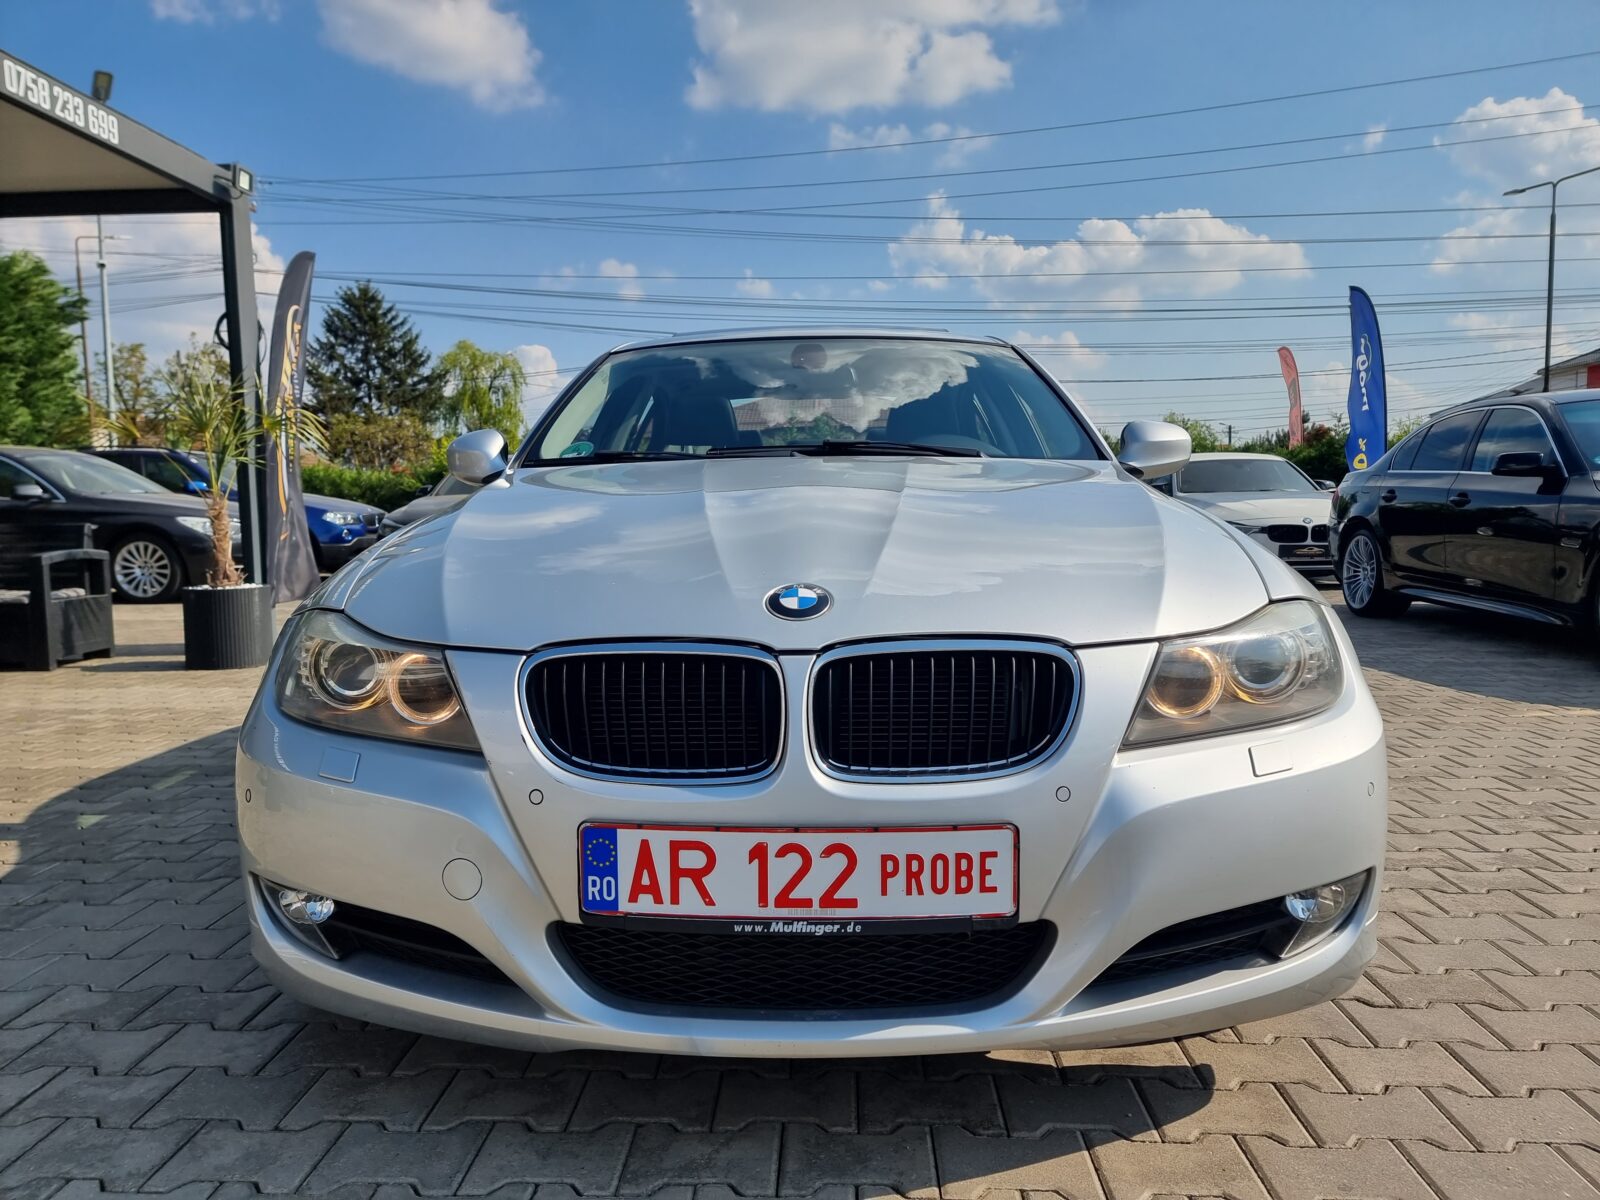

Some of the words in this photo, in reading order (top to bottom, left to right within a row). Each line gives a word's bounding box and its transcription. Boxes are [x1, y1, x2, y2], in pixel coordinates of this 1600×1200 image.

[3, 59, 51, 110] 0758
[53, 85, 85, 128] 233
[87, 104, 119, 145] 699
[588, 876, 615, 900] RO
[628, 839, 716, 906] AR
[749, 842, 858, 908] 122
[880, 851, 998, 896] PROBE
[734, 921, 862, 935] www.Mulfinger.de
